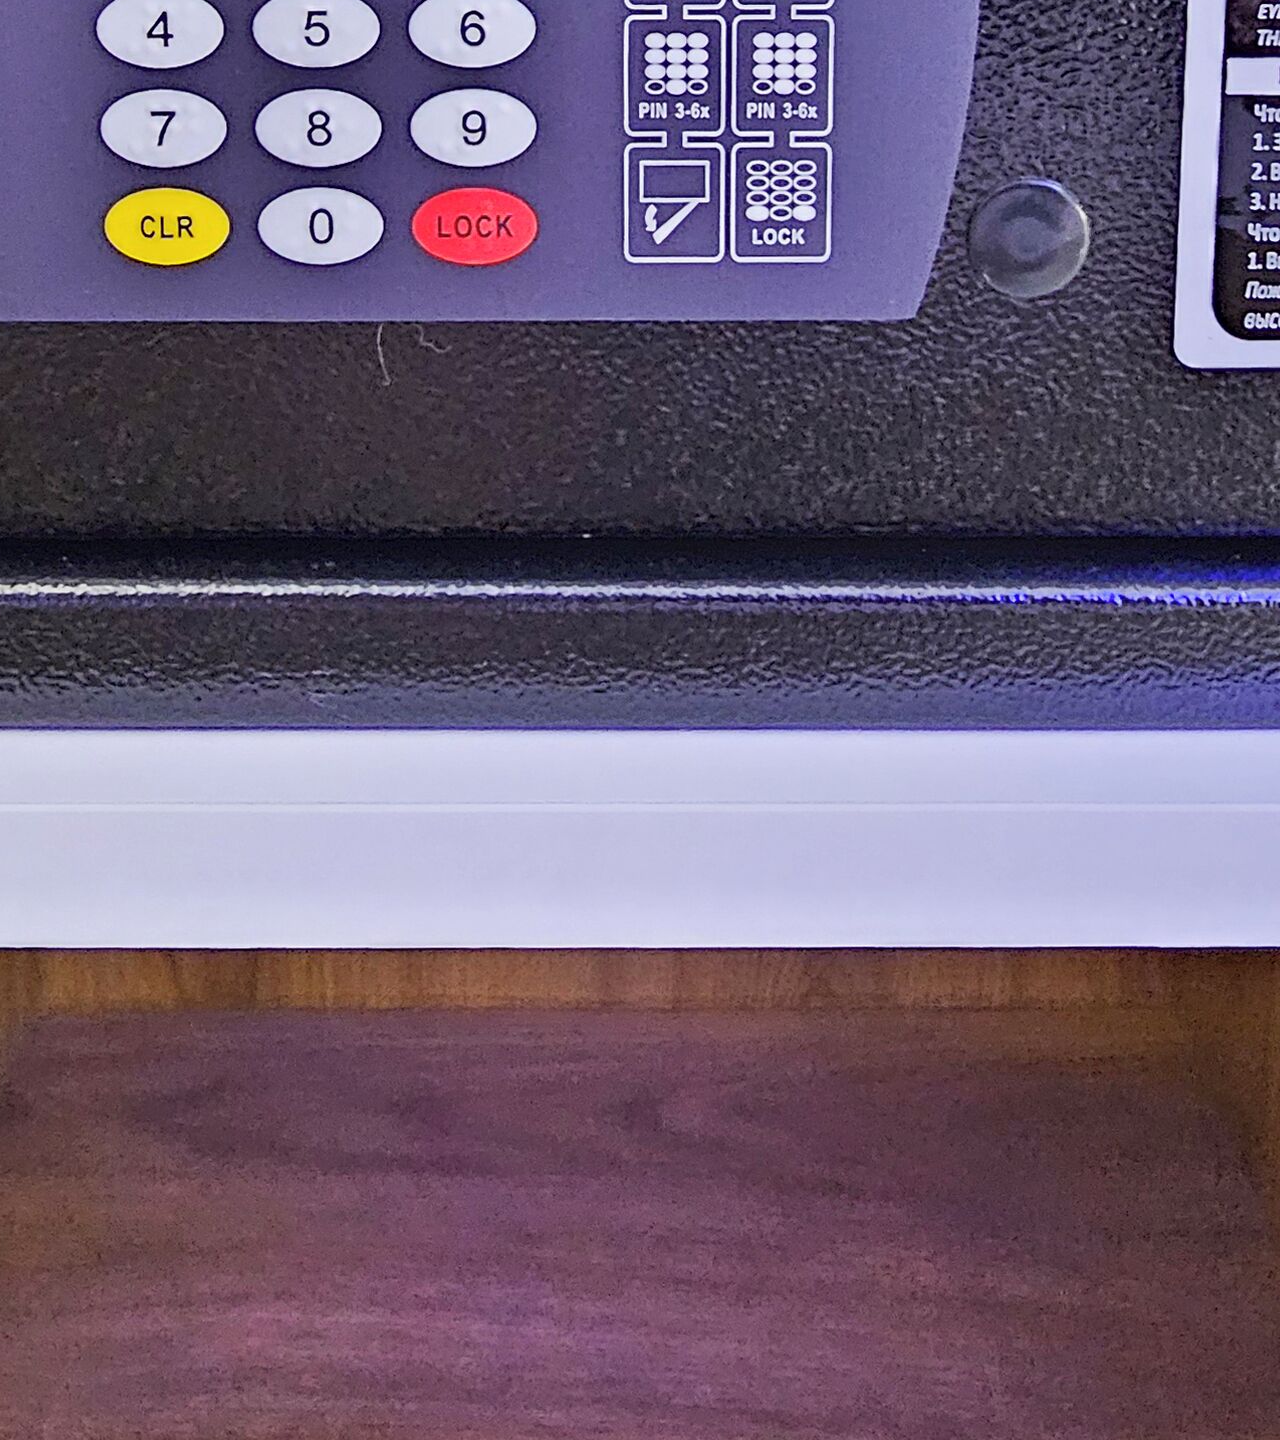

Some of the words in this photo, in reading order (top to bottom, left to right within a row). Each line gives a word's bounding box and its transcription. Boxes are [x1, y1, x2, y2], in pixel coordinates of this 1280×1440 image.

[146, 12, 175, 47] 4
[304, 10, 330, 47] 5
[460, 10, 486, 47] 6
[638, 103, 667, 119] PIN
[675, 103, 710, 120] 3-6x
[746, 103, 775, 119] PIN
[783, 103, 818, 120] 3-6x
[150, 111, 176, 146] 7
[307, 111, 332, 146] 8
[461, 111, 487, 146] 9
[1252, 134, 1270, 152] 1.
[1250, 163, 1268, 181] 2.
[1249, 193, 1266, 210] 3.
[140, 215, 194, 239] CLR
[309, 208, 334, 244] 0
[437, 215, 513, 239] LOCK
[752, 228, 805, 245] LOCK
[1247, 253, 1262, 270] 1.
